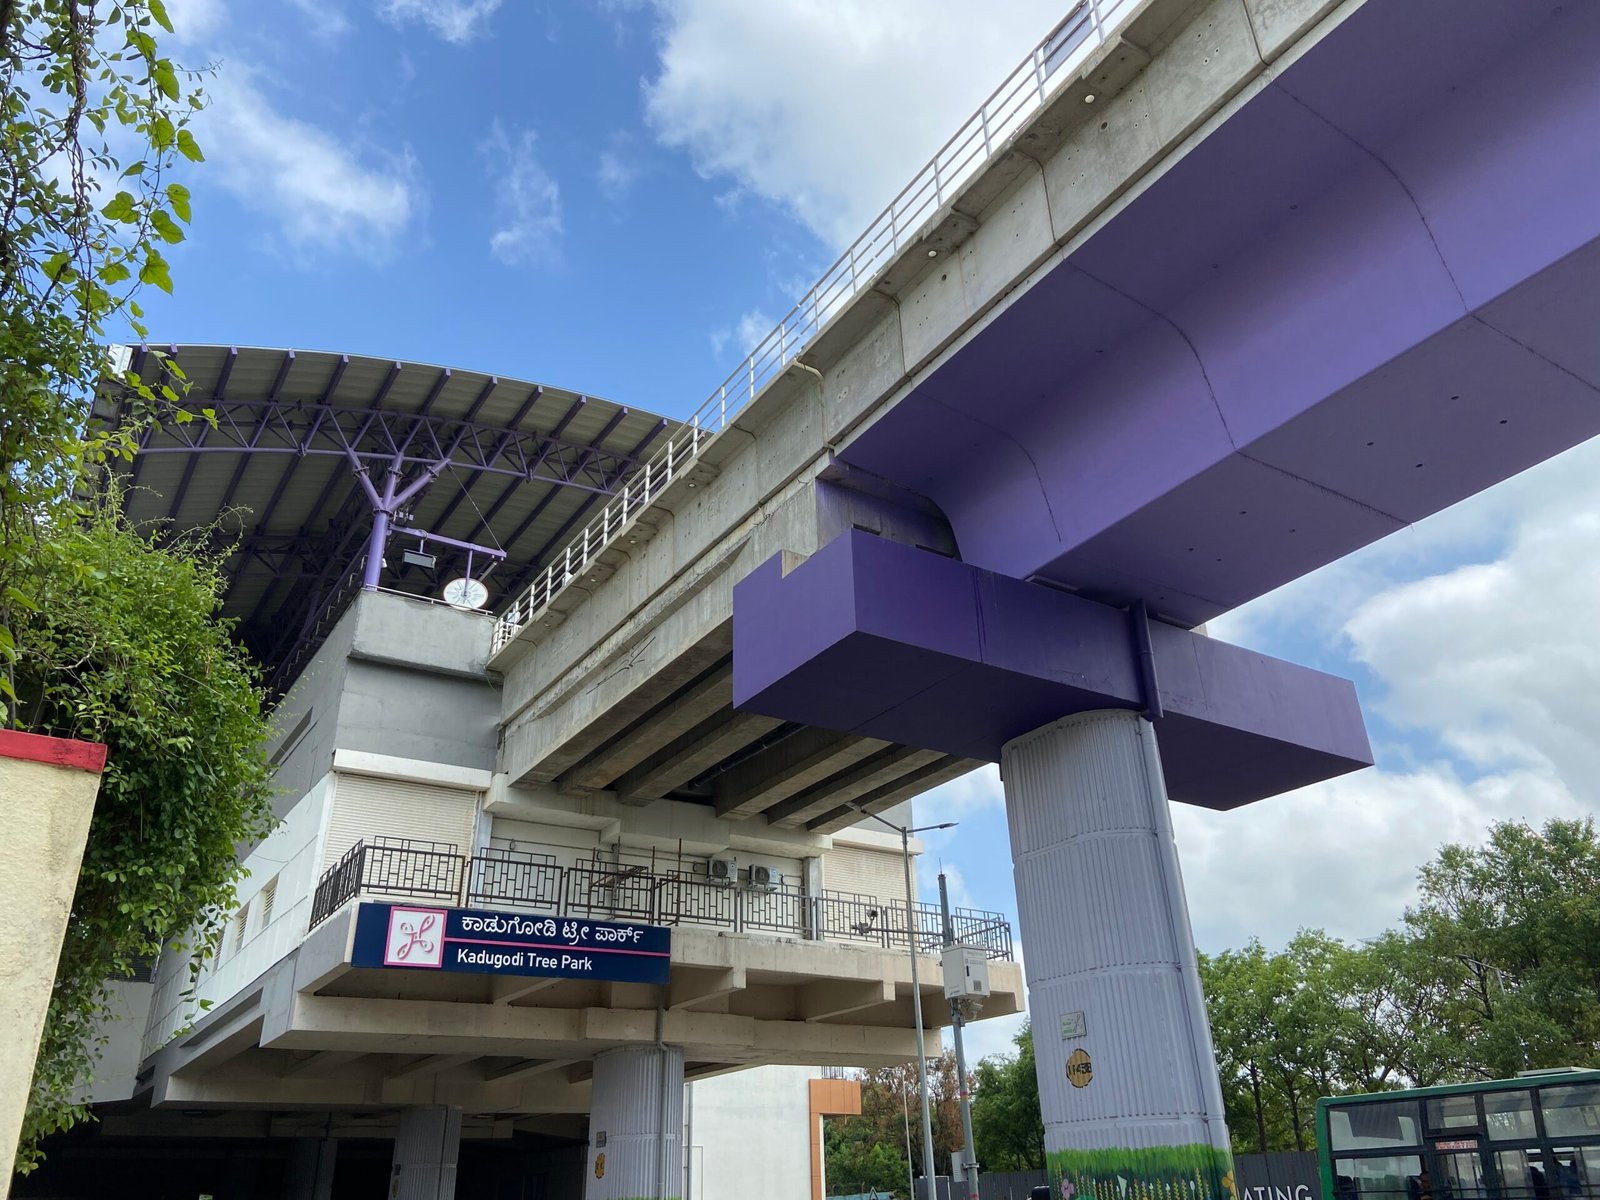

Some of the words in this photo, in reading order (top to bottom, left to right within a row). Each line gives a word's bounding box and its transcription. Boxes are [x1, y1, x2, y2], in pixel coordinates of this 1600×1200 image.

[461, 916, 556, 937] ಕಾಡುಗೋಡಿ
[562, 921, 589, 946] ಟ್ರೀ
[457, 949, 524, 968] Kadugodi
[527, 952, 558, 968] Tree
[561, 953, 593, 971] Park
